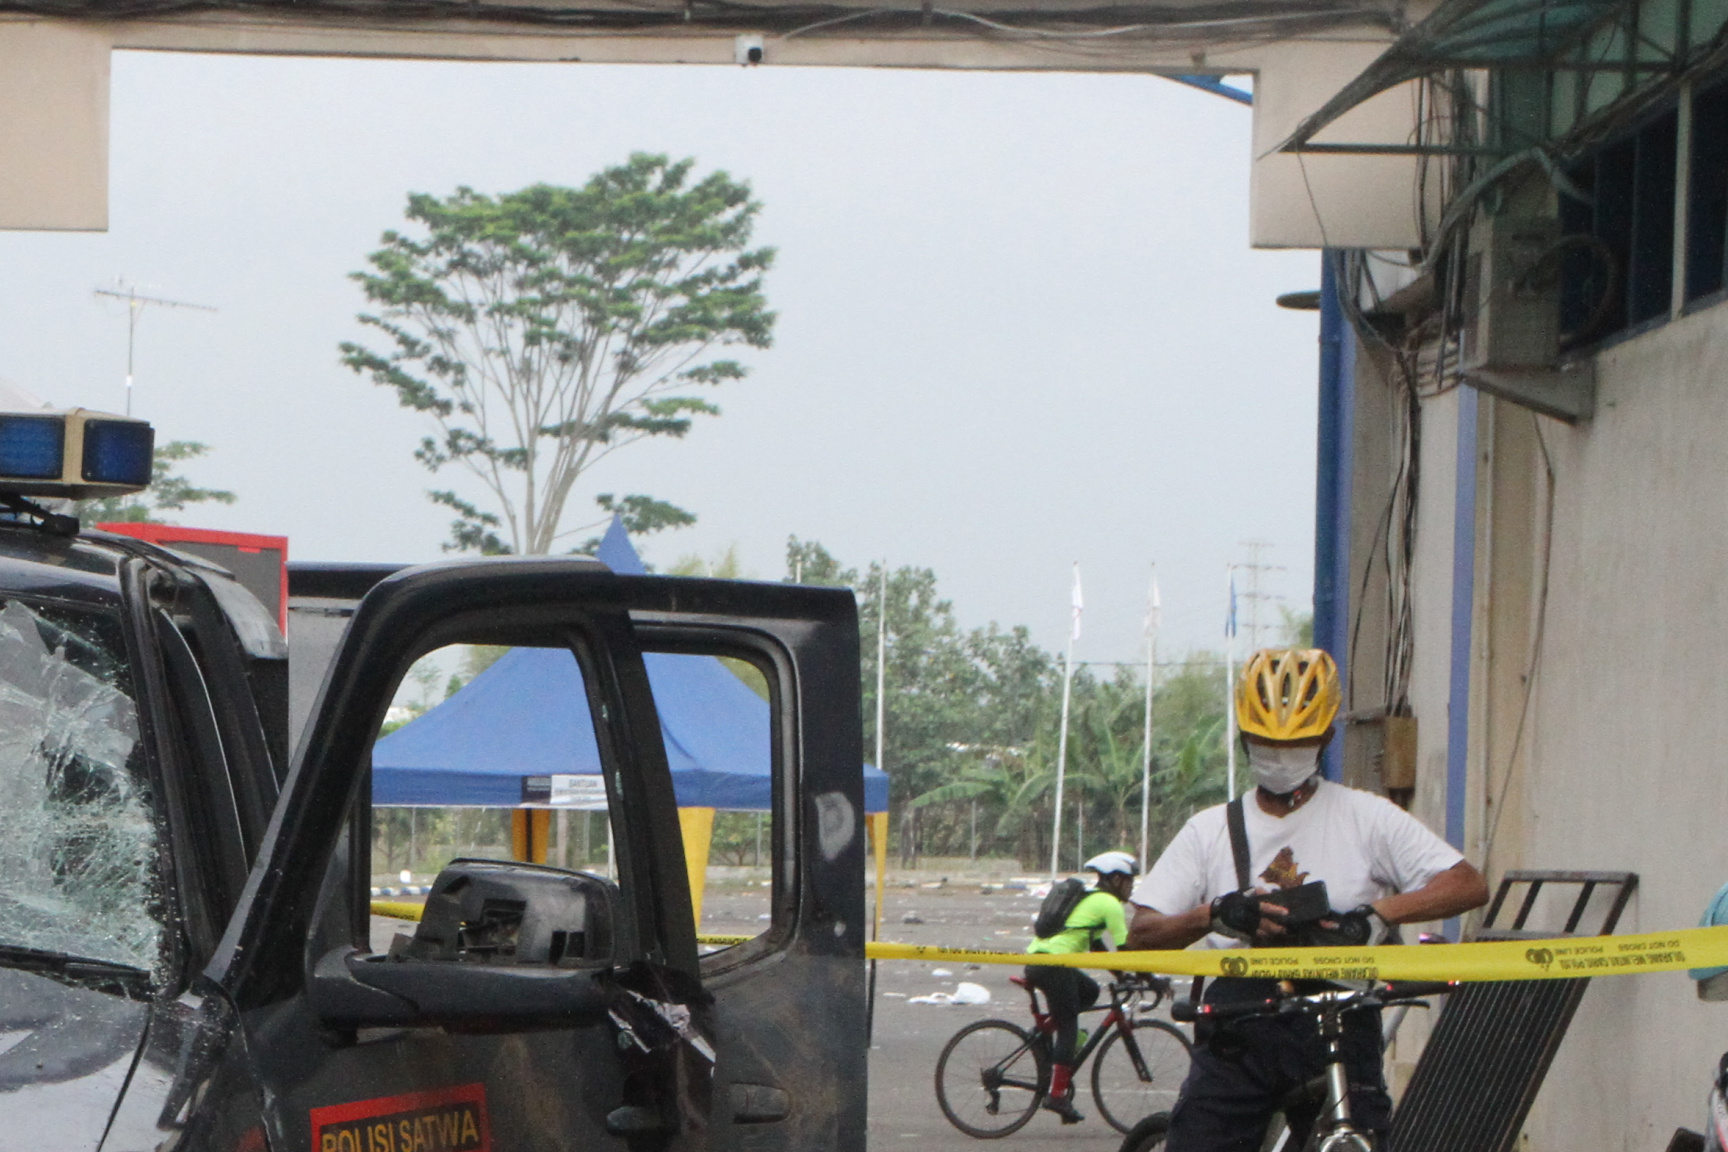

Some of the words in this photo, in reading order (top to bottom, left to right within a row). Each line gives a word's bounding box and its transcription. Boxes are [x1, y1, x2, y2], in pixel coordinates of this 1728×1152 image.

[1618, 943, 1647, 952] CROSS
[1649, 941, 1666, 950] NOT
[1667, 939, 1680, 949] DO
[1555, 947, 1572, 956] LINE
[1575, 945, 1603, 954] POLICE
[1250, 957, 1268, 966] LINE
[1271, 957, 1299, 965] POLICE
[1313, 957, 1342, 965] CROSS
